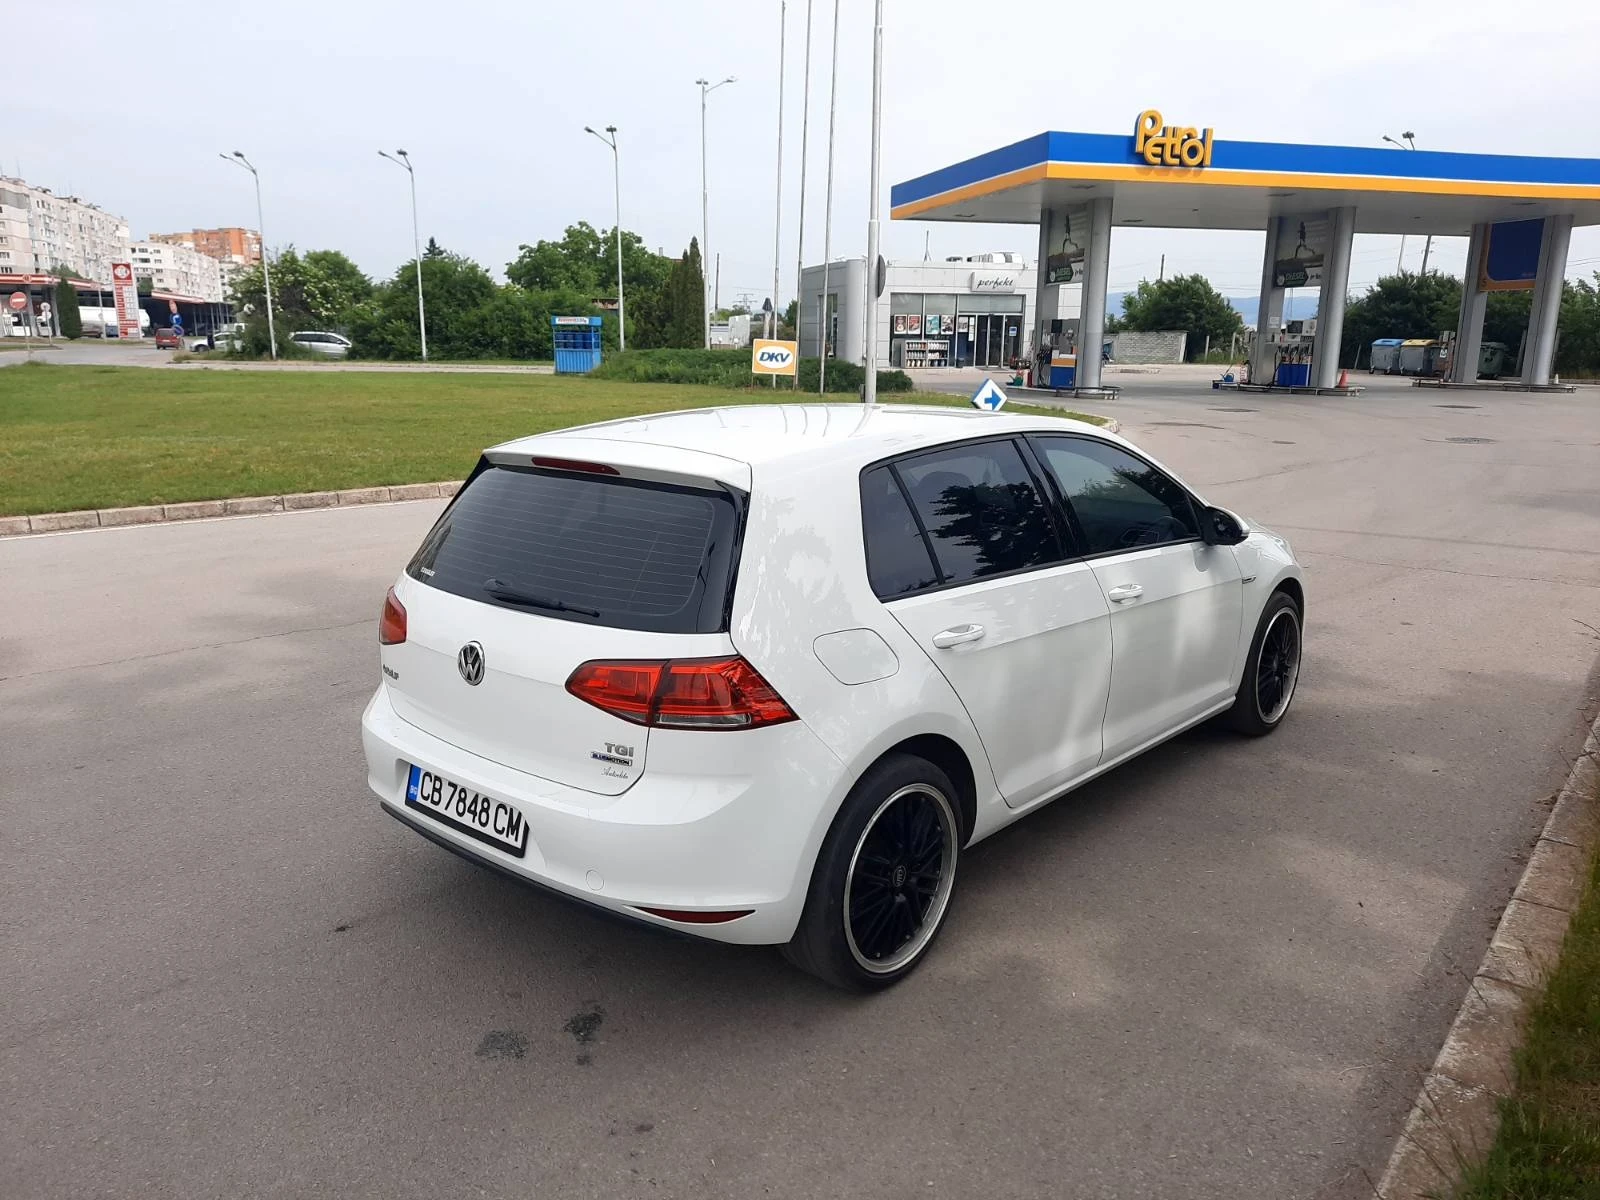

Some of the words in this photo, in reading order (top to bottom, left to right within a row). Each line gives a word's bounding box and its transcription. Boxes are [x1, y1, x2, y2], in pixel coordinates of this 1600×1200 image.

[1135, 109, 1213, 167] Petrol
[977, 277, 1014, 289] perfekt
[759, 351, 791, 362] DKV
[604, 742, 634, 757] TGI
[420, 771, 443, 806] CB
[444, 781, 491, 828] 7848
[493, 803, 522, 842] CM
